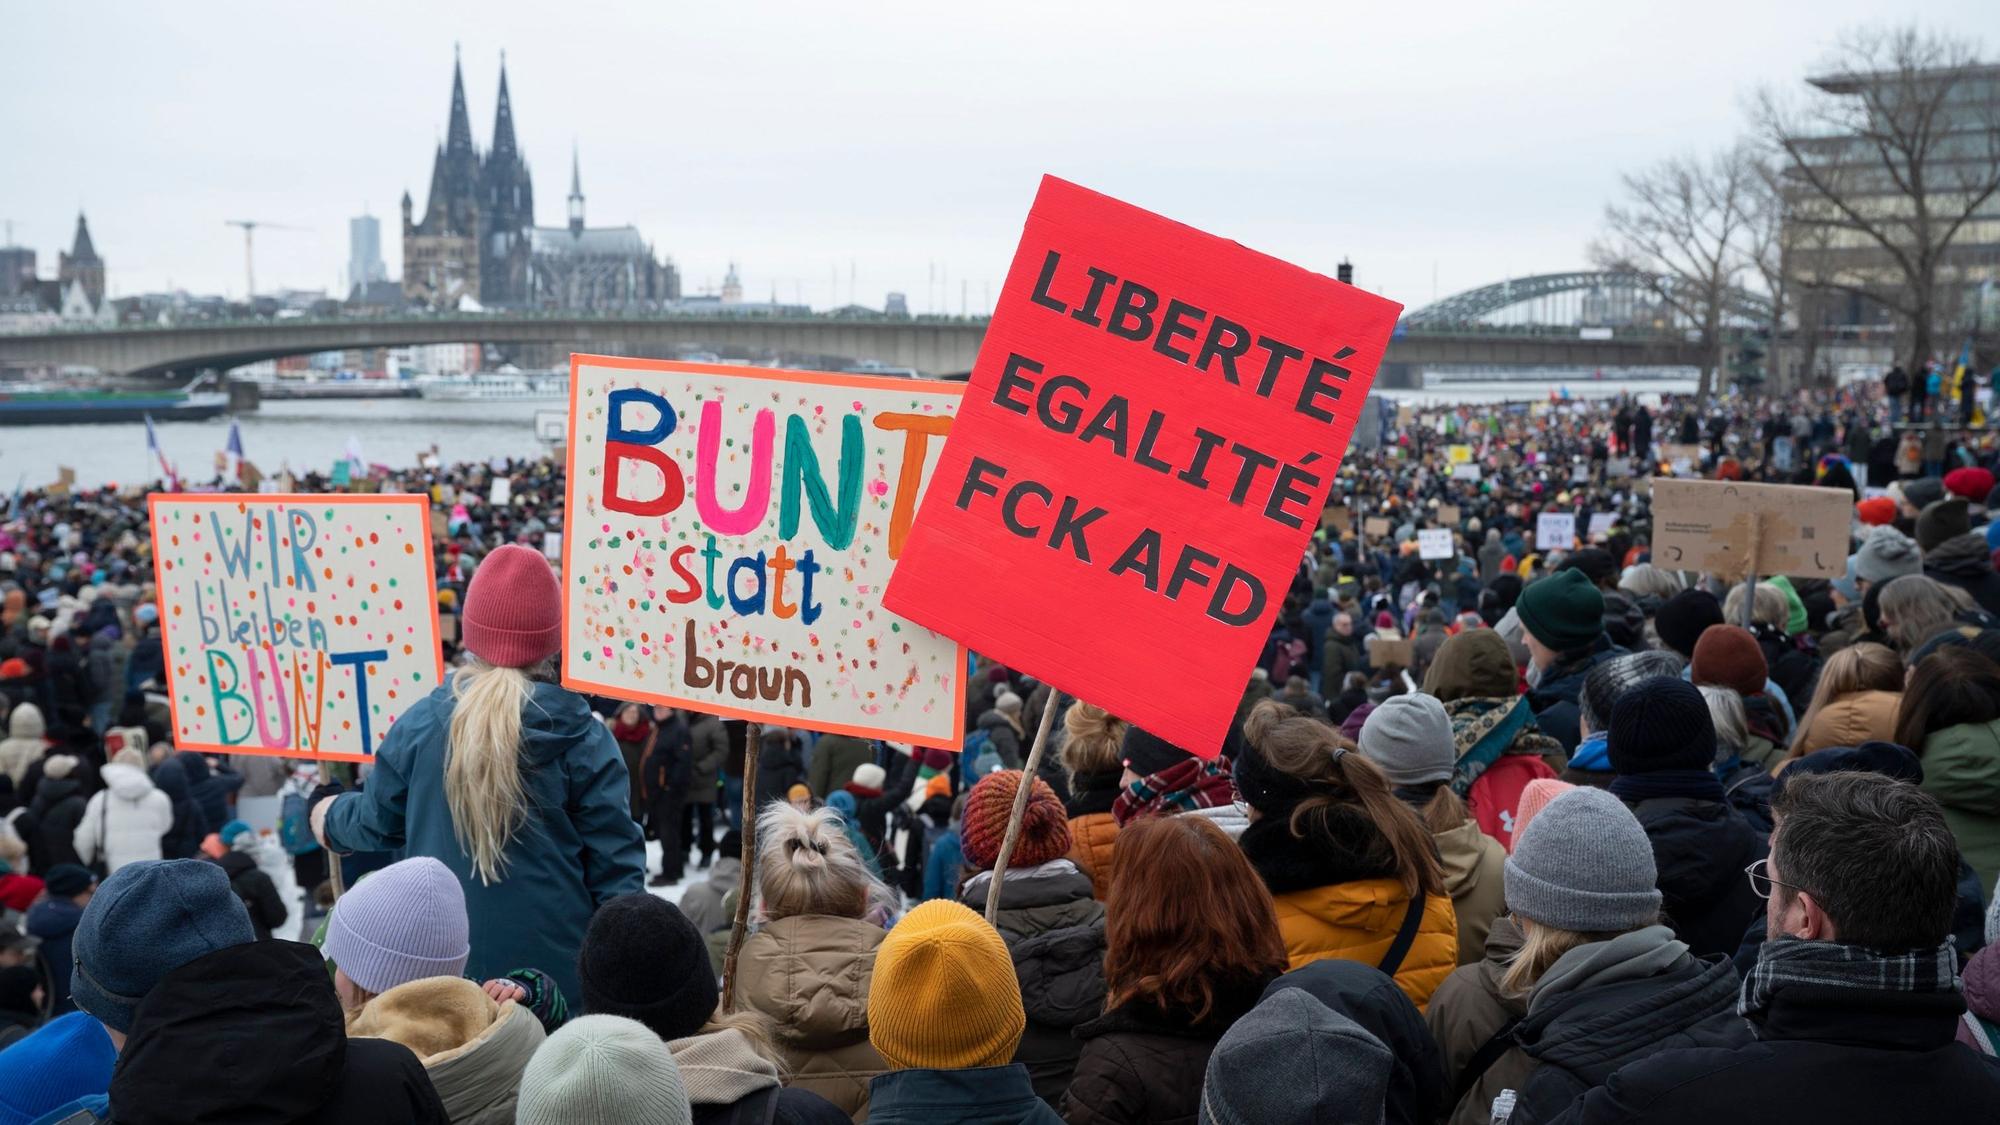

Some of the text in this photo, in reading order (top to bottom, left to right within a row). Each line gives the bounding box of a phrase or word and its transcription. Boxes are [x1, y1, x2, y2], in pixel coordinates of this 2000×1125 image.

[1030, 250, 1356, 425] LIBERTÉ
[603, 387, 956, 560] BUNT
[992, 352, 1322, 530] EGALITÉ
[210, 508, 317, 592] WIR
[666, 535, 821, 626] statt
[956, 457, 1267, 627] FCK AFD
[194, 579, 328, 651] bleiben
[683, 618, 811, 708] braun
[205, 645, 388, 755] BUNT
